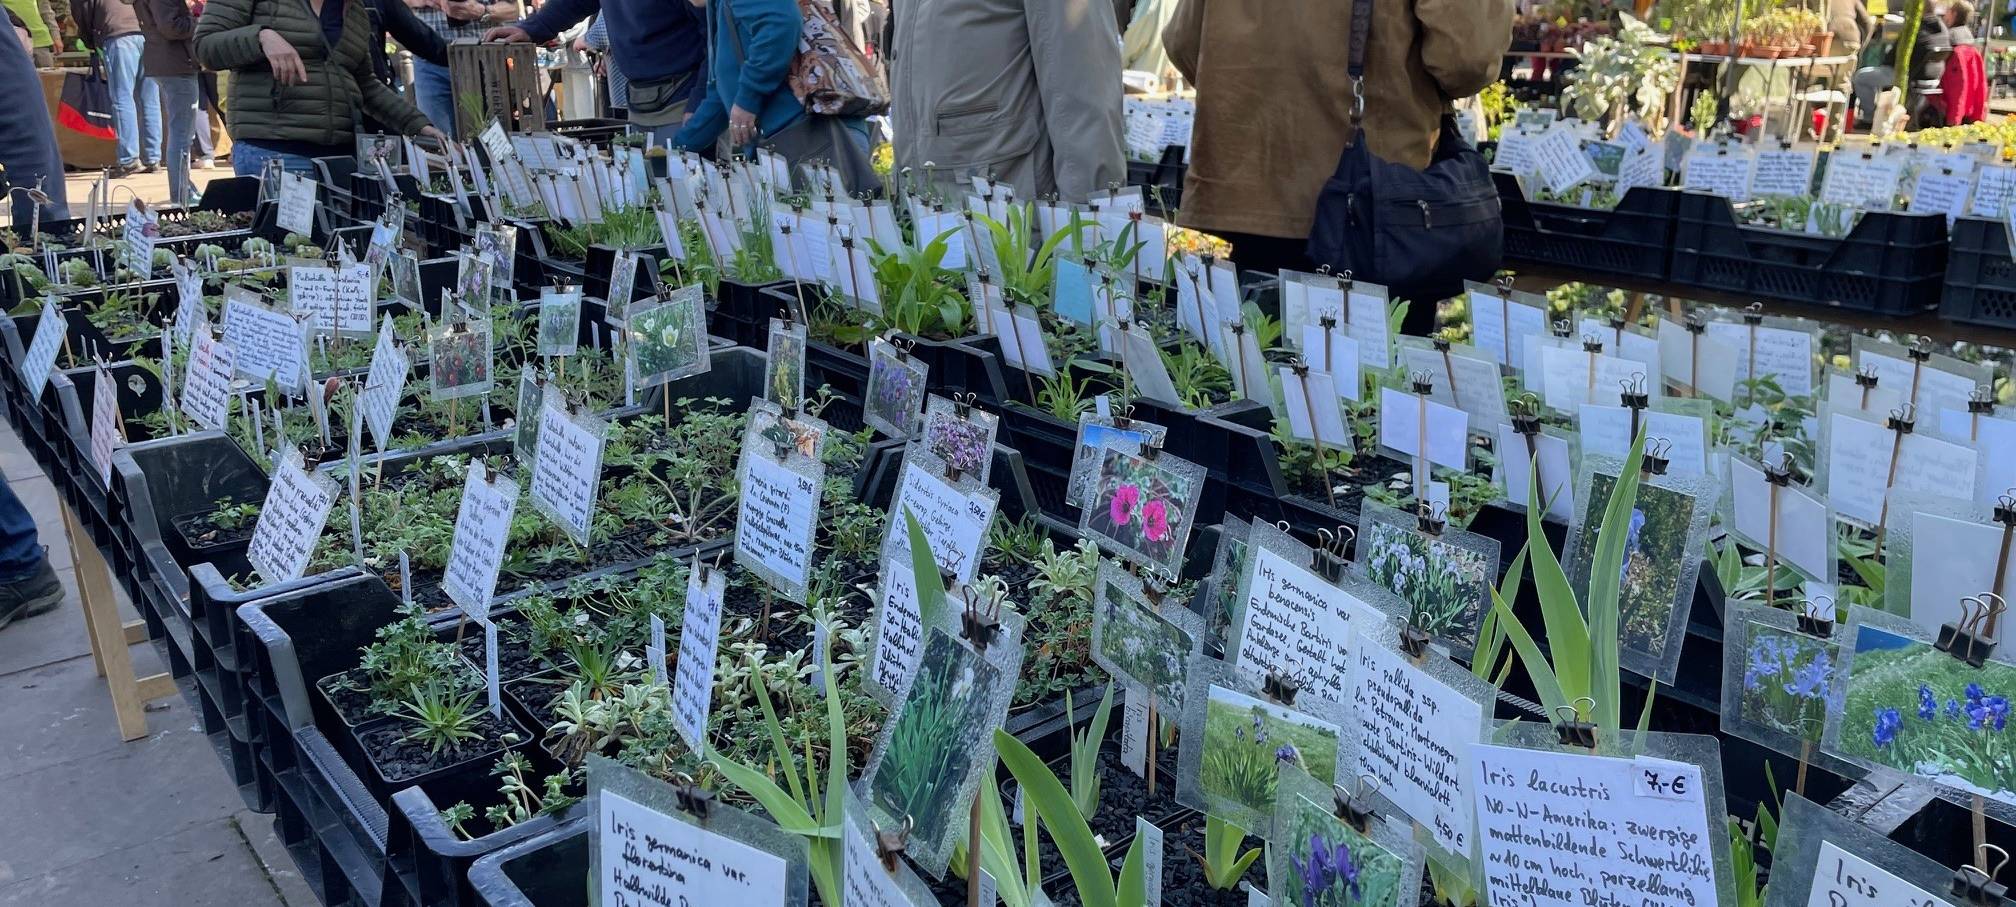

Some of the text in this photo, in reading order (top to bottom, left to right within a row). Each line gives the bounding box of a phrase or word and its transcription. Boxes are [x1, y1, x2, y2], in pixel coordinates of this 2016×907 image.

[892, 571, 909, 599] Iris
[1258, 559, 1275, 582] Iris
[1281, 578, 1328, 611] germanica
[1268, 583, 1315, 622] benacensis
[1359, 646, 1440, 716] Iris pallida ssp.
[1367, 679, 1423, 724] pseudopallida
[1482, 760, 1610, 800] Iris lacustris
[612, 810, 750, 887] Iris germanica var.
[1489, 824, 1607, 858] mattenbildende
[1625, 820, 1698, 850] zwergige
[1489, 872, 1572, 902] mittelblaue
[1836, 858, 1878, 899] Iris
